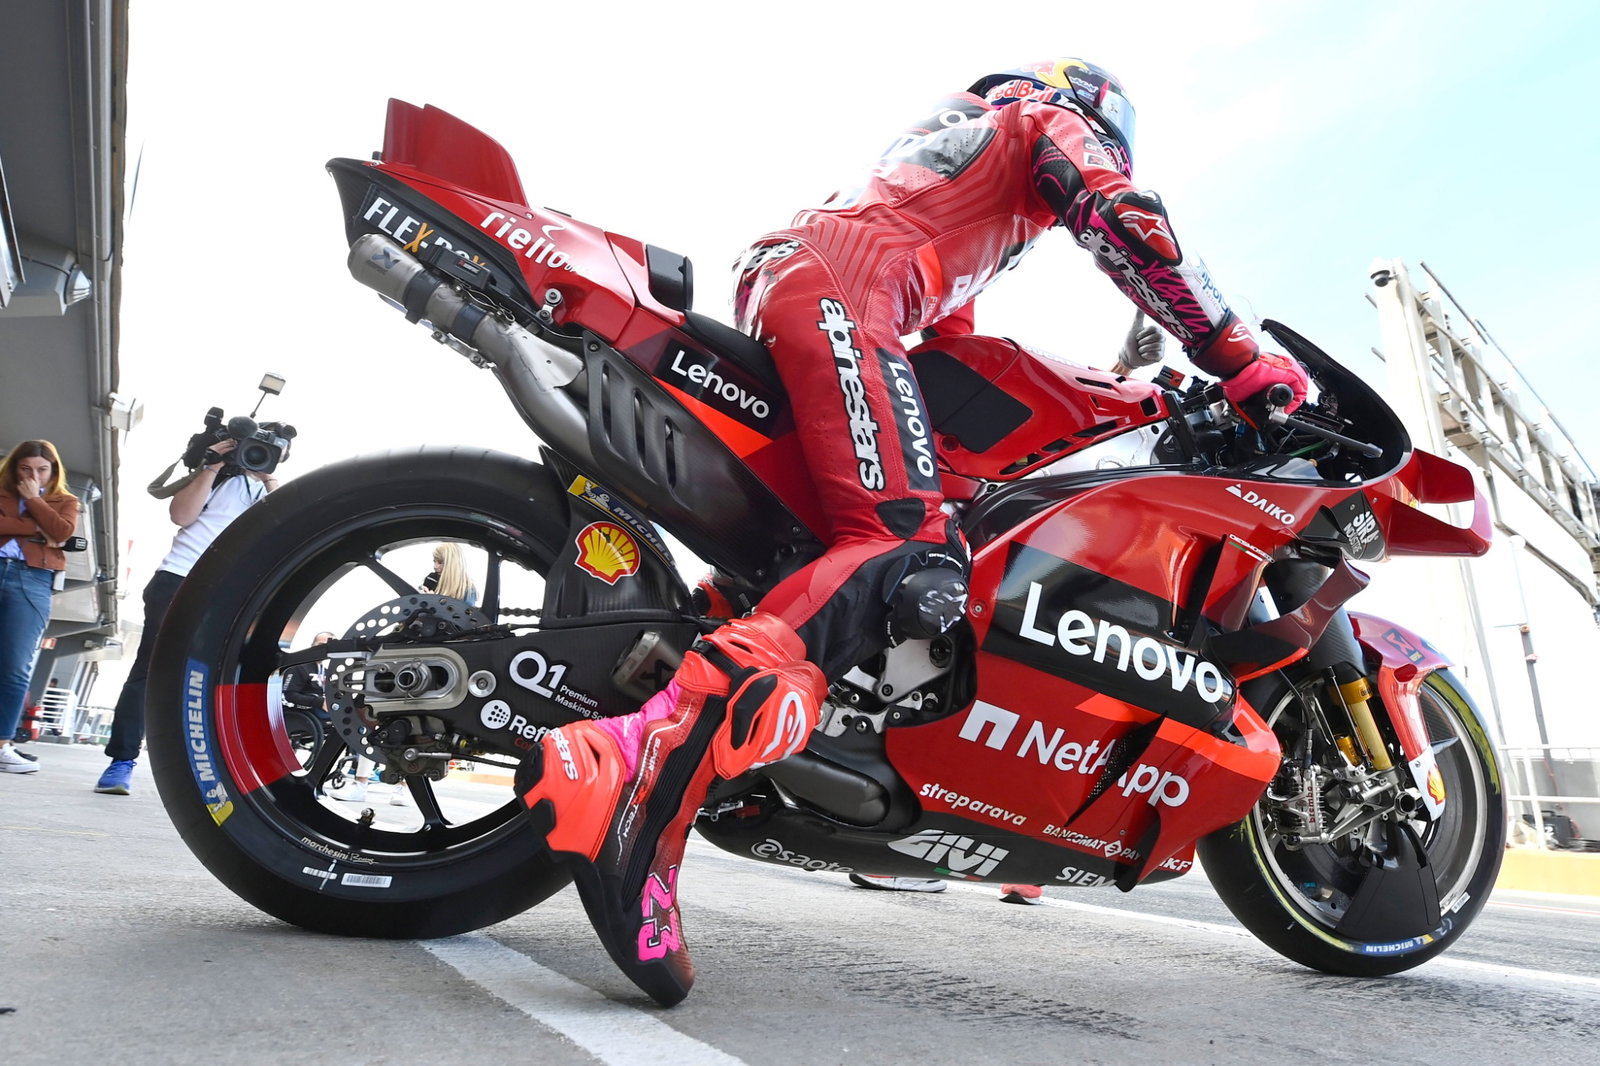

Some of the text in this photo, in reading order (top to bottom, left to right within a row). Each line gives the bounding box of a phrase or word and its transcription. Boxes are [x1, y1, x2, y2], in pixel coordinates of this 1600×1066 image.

[480, 211, 571, 268] riello
[1078, 227, 1195, 341] alpinestars
[671, 350, 770, 420] Lenovo
[817, 297, 886, 491] alpinestars
[887, 360, 935, 478] Lenovo
[1242, 490, 1296, 525] DAIKO
[1018, 580, 1225, 704] Lenovo
[508, 650, 567, 699] Q1
[559, 684, 599, 708] Premium
[189, 670, 216, 782] MICHELIN
[554, 694, 591, 719] Masking
[1016, 719, 1191, 808] NetApp
[919, 782, 1027, 827] streparava
[1306, 786, 1316, 824] brembo
[300, 836, 350, 861] marchesini
[750, 838, 854, 873] esaote
[887, 828, 1010, 878] GIVI
[1042, 823, 1142, 861] BANCOMAT PAY
[1159, 857, 1193, 872] KF
[1055, 866, 1118, 889] SIEM
[1365, 940, 1415, 953] MICHELIN
